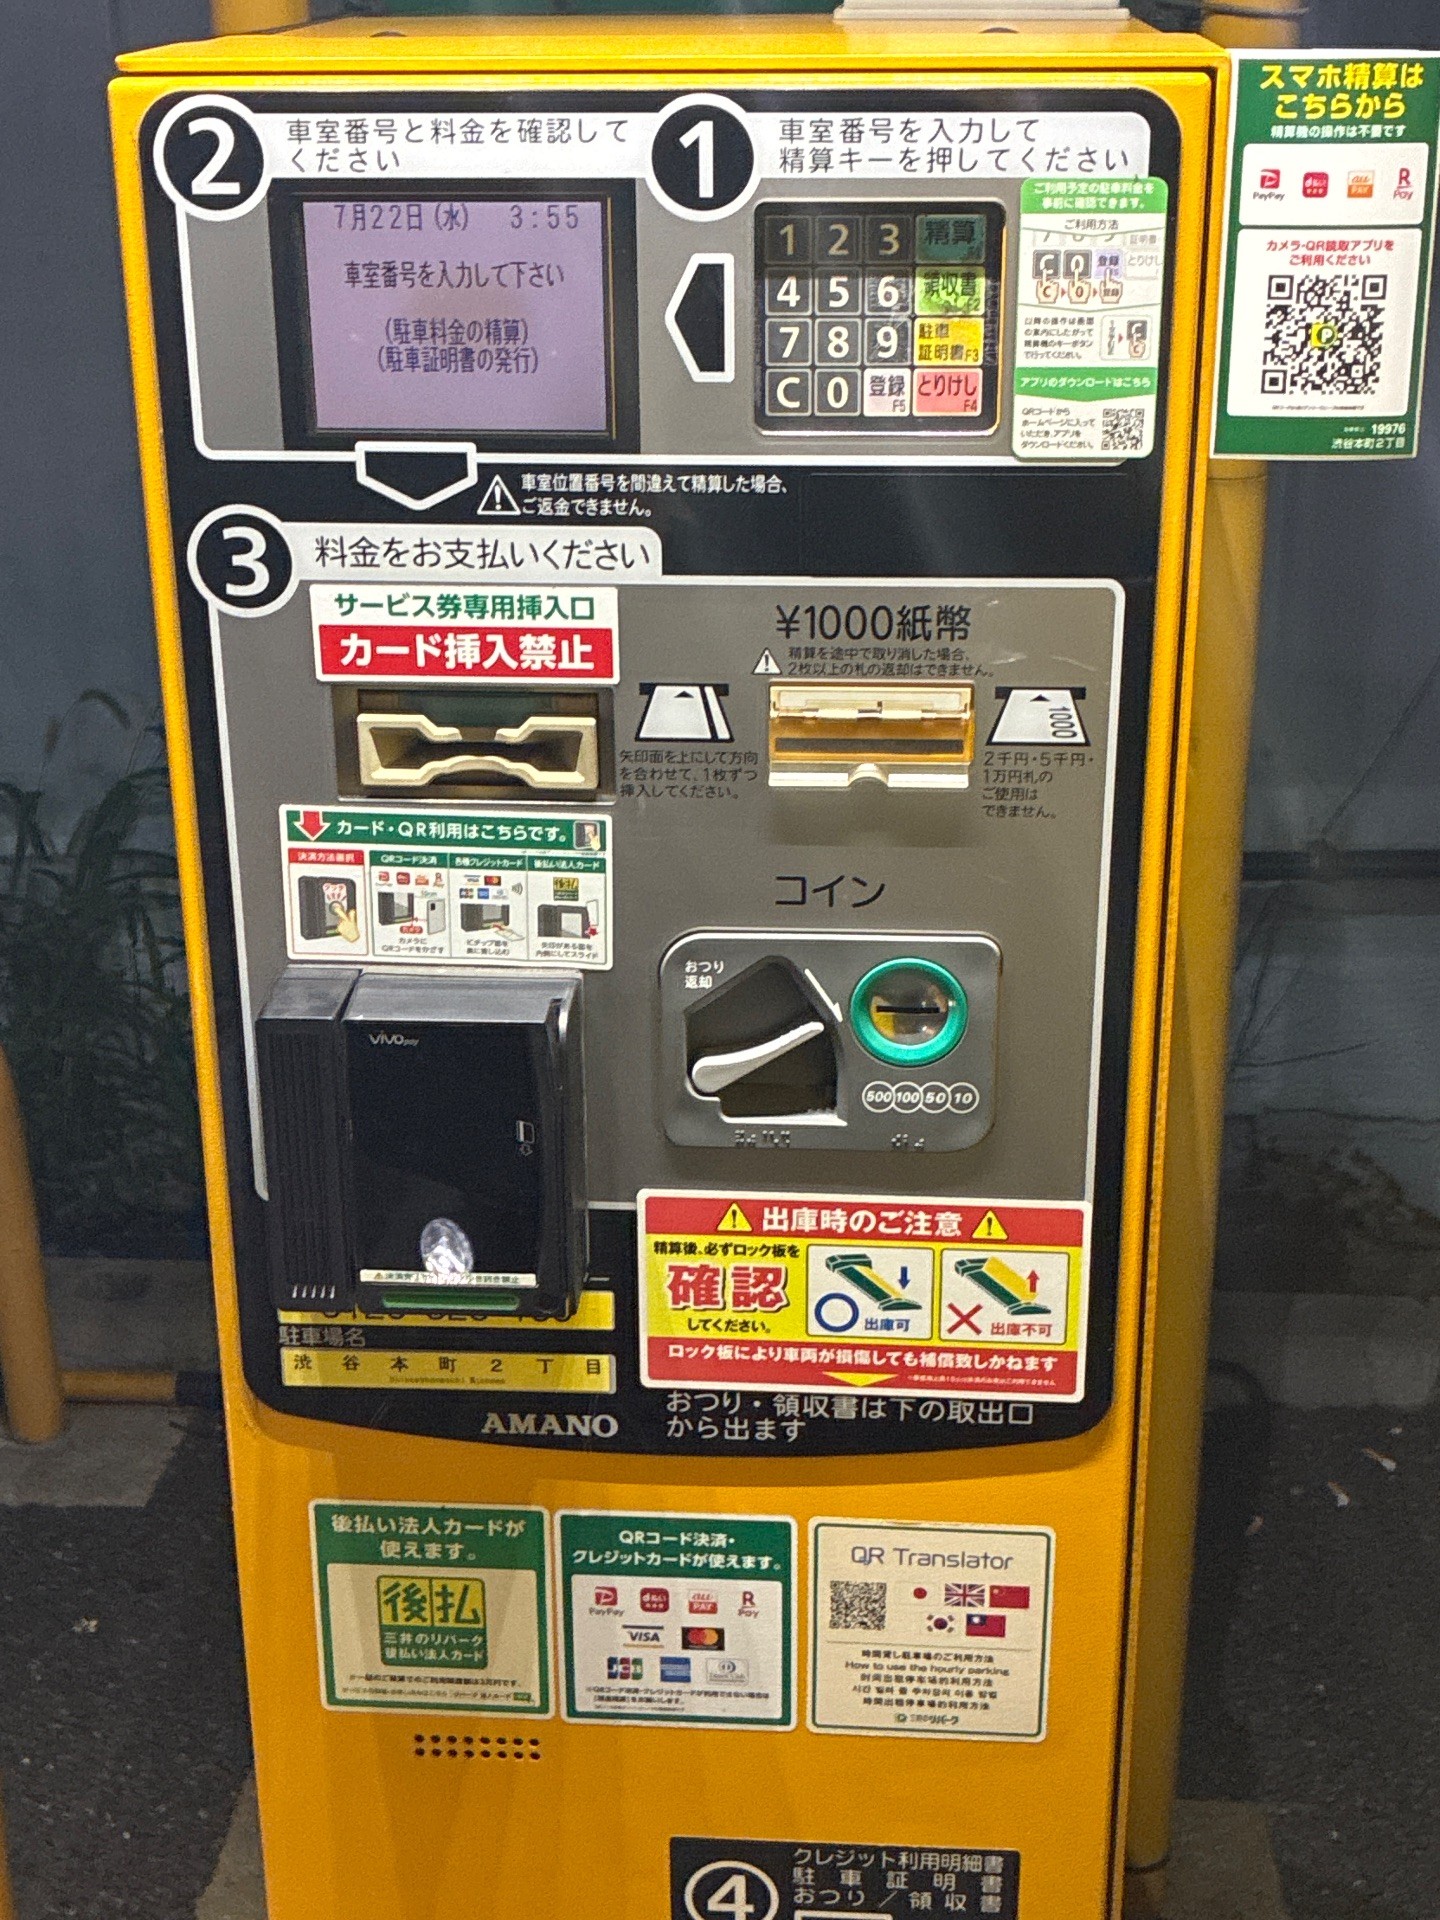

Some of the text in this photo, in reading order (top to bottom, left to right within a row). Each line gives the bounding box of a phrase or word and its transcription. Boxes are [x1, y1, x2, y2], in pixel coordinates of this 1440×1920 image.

[1260, 63, 1424, 90] スマホ精算は
[1275, 92, 1405, 120] こちらから
[287, 118, 629, 146] 車室番号と料金を確認して
[779, 118, 1039, 145] 車室番号を入力して
[187, 118, 241, 196] 2
[288, 149, 400, 174] ください
[679, 121, 714, 197] 1
[779, 147, 1128, 173] 精算キーを押してください
[510, 204, 579, 229] 3:55
[1064, 218, 1119, 230] ご利用方法
[779, 224, 793, 256] 1
[828, 224, 849, 256] 2
[879, 223, 899, 255] 3
[925, 220, 975, 245] 精算
[1290, 255, 1371, 266] ご利用ください
[344, 261, 564, 290] 車室番号を入力して下さい
[777, 276, 800, 308] 4
[828, 276, 849, 308] 5
[877, 275, 899, 308] 6
[385, 318, 529, 345] (駐車料金の精算)
[779, 327, 799, 358] 7
[827, 327, 849, 358] 8
[876, 326, 898, 358] 9
[919, 324, 949, 339] 駐車
[377, 347, 538, 374] (駐車証明書の発行)
[919, 345, 964, 361] 証明書
[965, 349, 979, 362] F3
[777, 377, 800, 409] C
[827, 377, 848, 409] 0
[869, 375, 905, 396] 登録
[918, 375, 977, 397] とりけし
[1020, 377, 1151, 388] アプリのダウンロードはこちら
[521, 473, 787, 494] 車室位置番号を間違えて精算した場合、
[522, 497, 652, 517] ご返金できません。
[221, 527, 270, 597] 3
[315, 536, 649, 571] 料金をお支払いください
[334, 593, 595, 620] サービス券専用挿入口
[339, 633, 594, 670] カード挿入禁止
[1050, 706, 1078, 738] 1000
[620, 750, 758, 764] 矢印面を上にして方向
[983, 770, 1052, 784] 1万円札の
[620, 784, 739, 799] 挿入してください。
[982, 787, 1038, 801] ご使用は
[981, 805, 1057, 819] できません。
[775, 875, 885, 907] コイン
[684, 960, 725, 974] おつり
[684, 976, 712, 989] 返却
[866, 1091, 973, 1104] 500 100 50 10
[762, 1207, 962, 1238] 出庫時のご注意
[668, 1263, 788, 1314] 確認
[279, 1327, 366, 1347] 駐車場名
[687, 1318, 773, 1334] してください。
[864, 1317, 911, 1333] 出庫可
[990, 1321, 1053, 1338] 出庫不可
[668, 1344, 1058, 1373] ロック板により車両が損傷しても補償致しかねます
[666, 1391, 1034, 1426] おつり・領収書は下の取出口
[481, 1412, 619, 1439] AMANO
[666, 1416, 806, 1442] から出ます
[332, 1514, 526, 1537] 後払い法人カードが
[381, 1540, 476, 1560] 使えます。
[572, 1550, 782, 1571] クレジットカードが使えます。
[851, 1546, 1013, 1570] QR Translator
[383, 1582, 481, 1625] 後払
[383, 1632, 484, 1647] 三井のリパーク
[628, 1631, 660, 1642] VISA
[384, 1648, 484, 1661] 後払い法人カード
[845, 1661, 869, 1669] How
[873, 1662, 884, 1670] to
[910, 1664, 927, 1672] the
[930, 1665, 965, 1675] hourly
[968, 1667, 1009, 1677] parking
[793, 1849, 1004, 1873] クレジット利用明細書
[707, 1874, 755, 1920] 4
